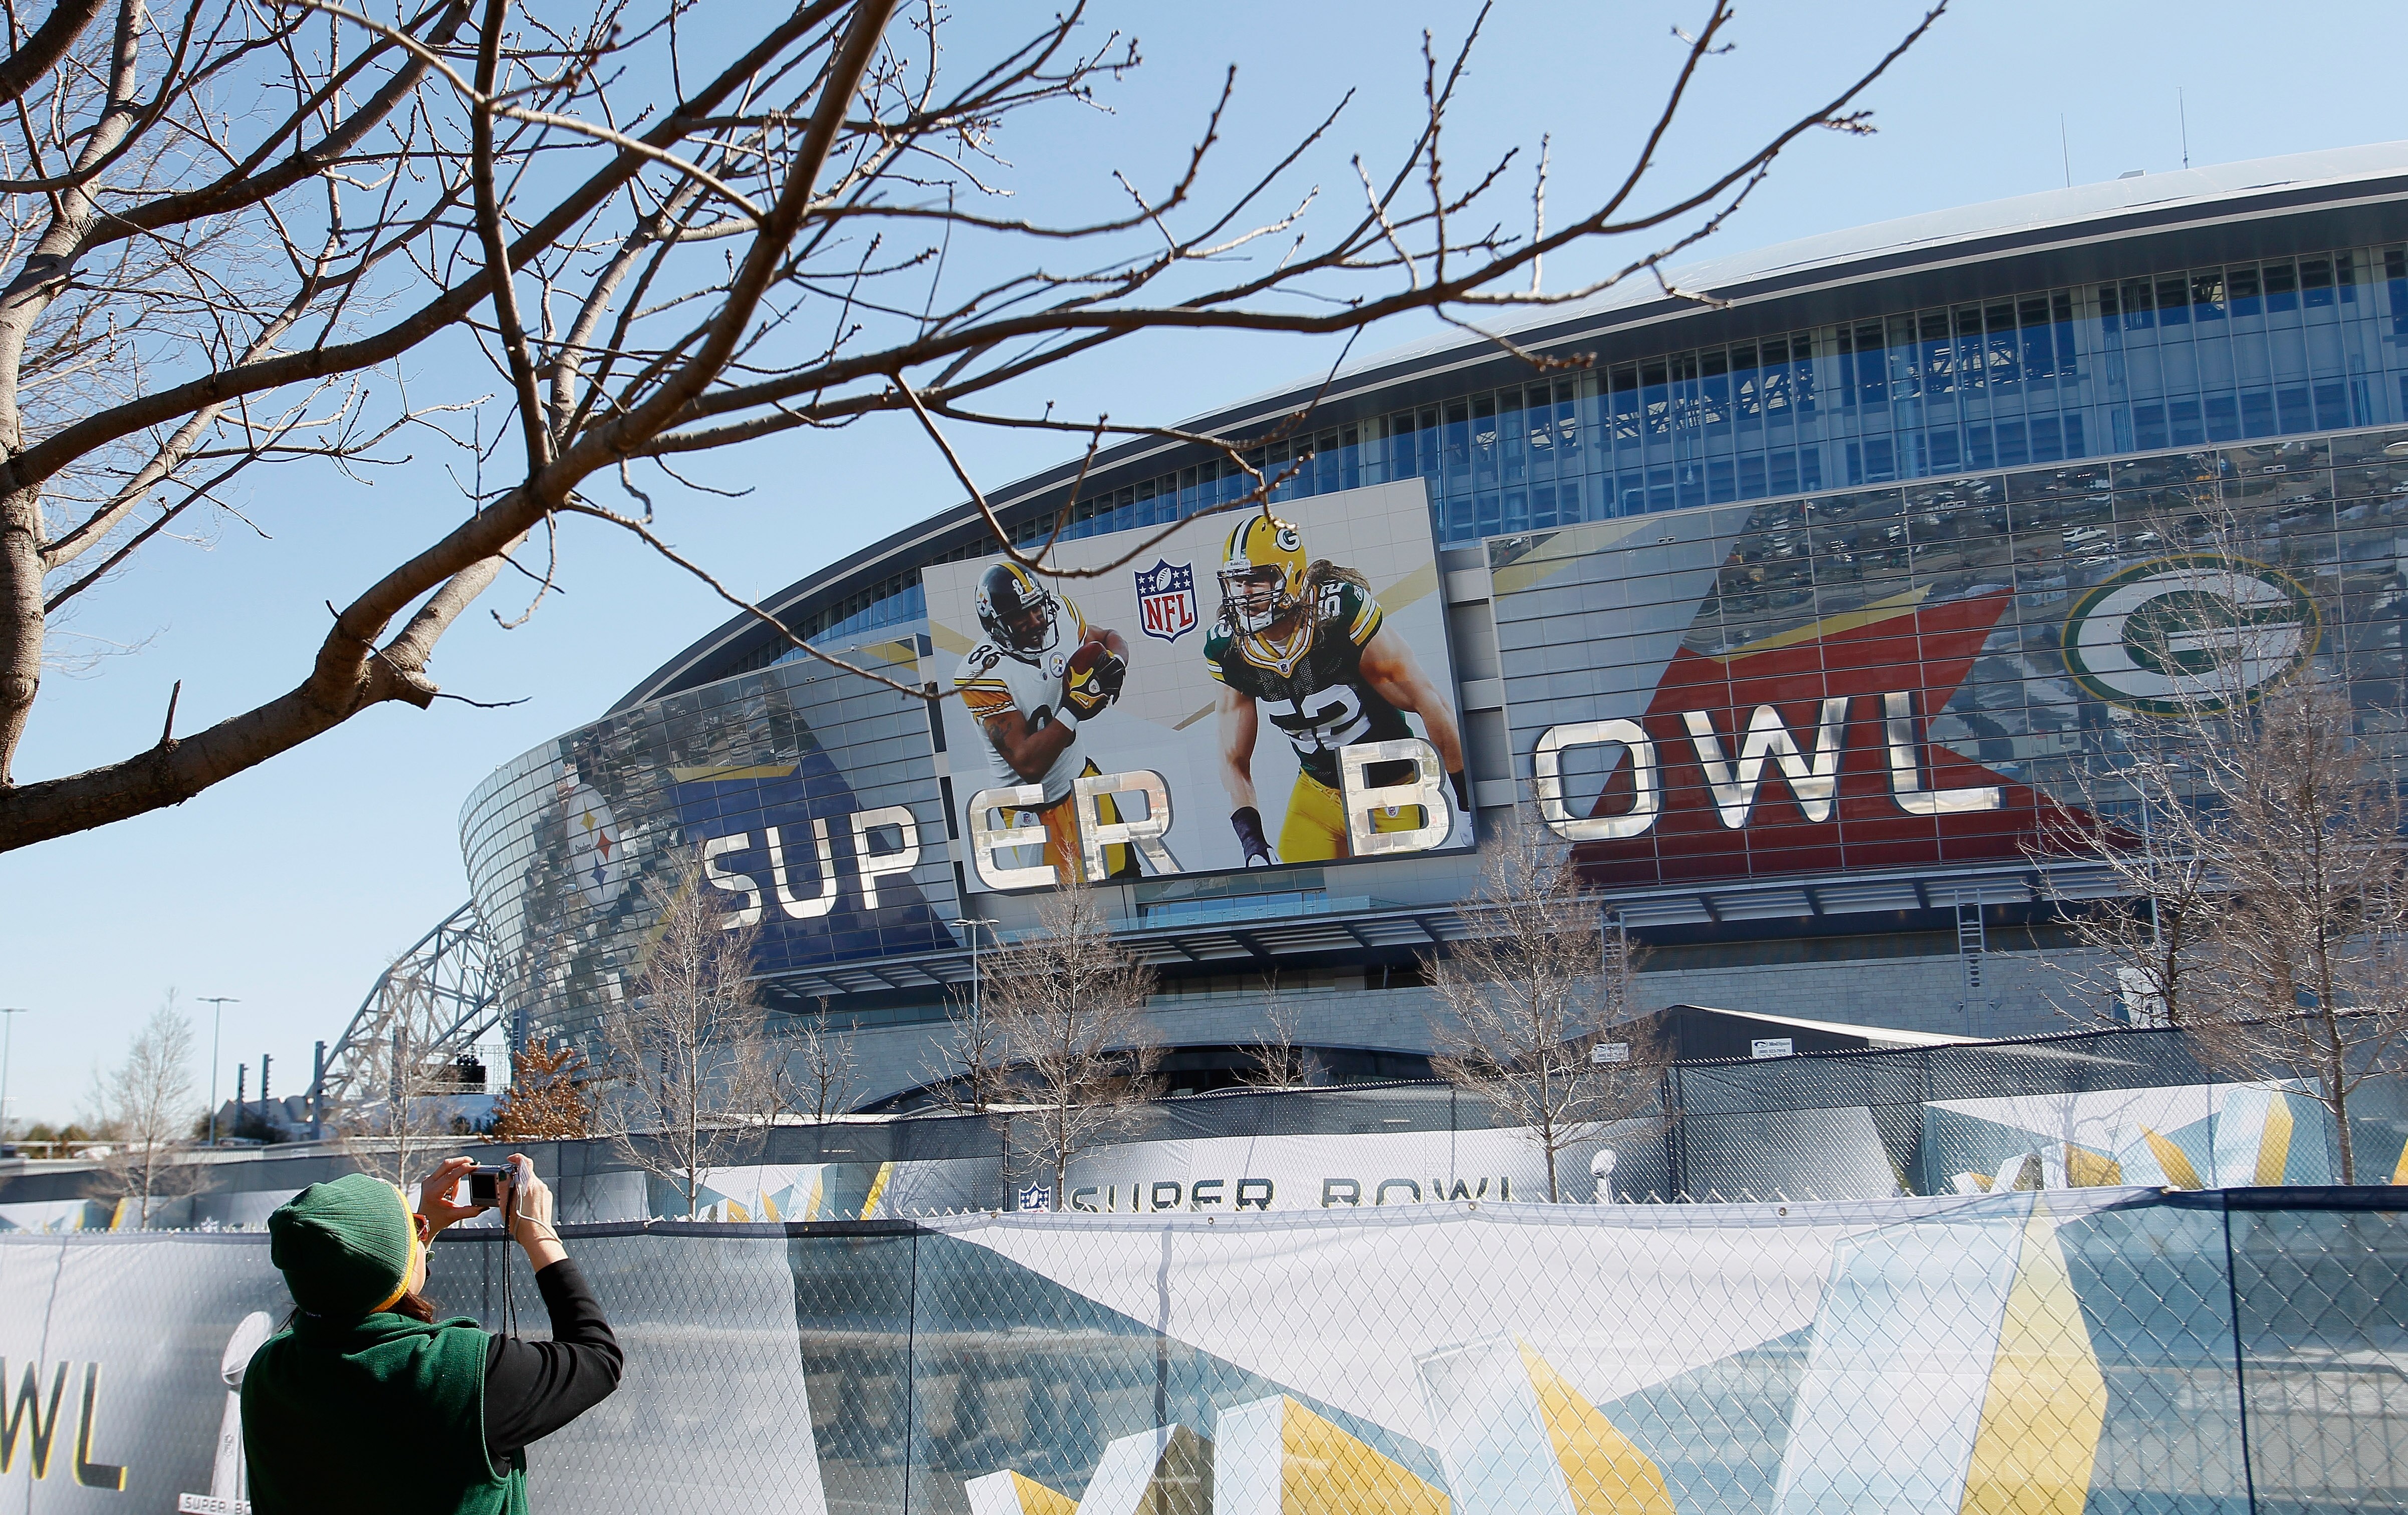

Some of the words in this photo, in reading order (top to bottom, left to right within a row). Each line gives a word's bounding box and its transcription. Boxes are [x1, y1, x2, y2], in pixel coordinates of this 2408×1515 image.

[1012, 572, 1036, 596] 86
[1144, 593, 1193, 633] NFL
[1257, 684, 1372, 754] 52
